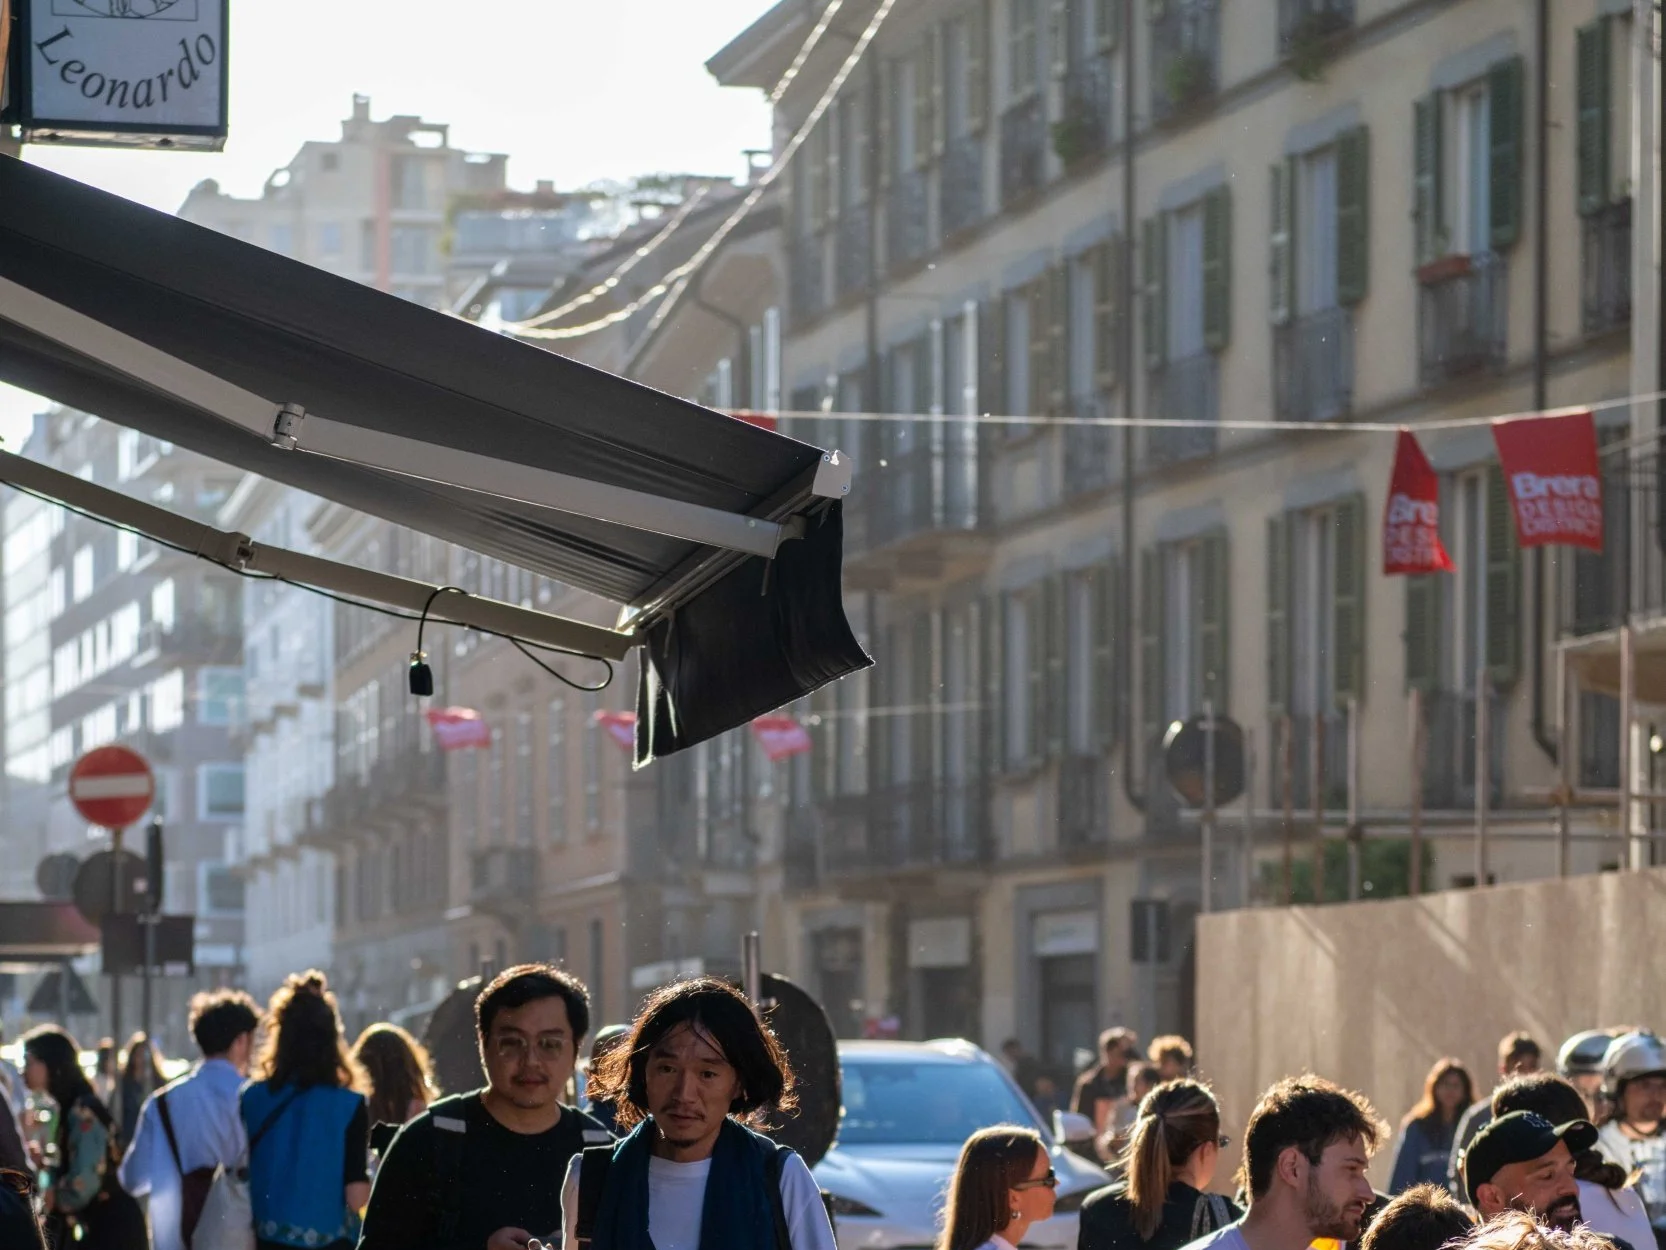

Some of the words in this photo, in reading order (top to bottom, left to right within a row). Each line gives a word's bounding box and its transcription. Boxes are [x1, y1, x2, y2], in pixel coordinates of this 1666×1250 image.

[35, 24, 215, 109] Leonardo
[1511, 472, 1599, 499] Brera
[1389, 493, 1439, 525] Bre
